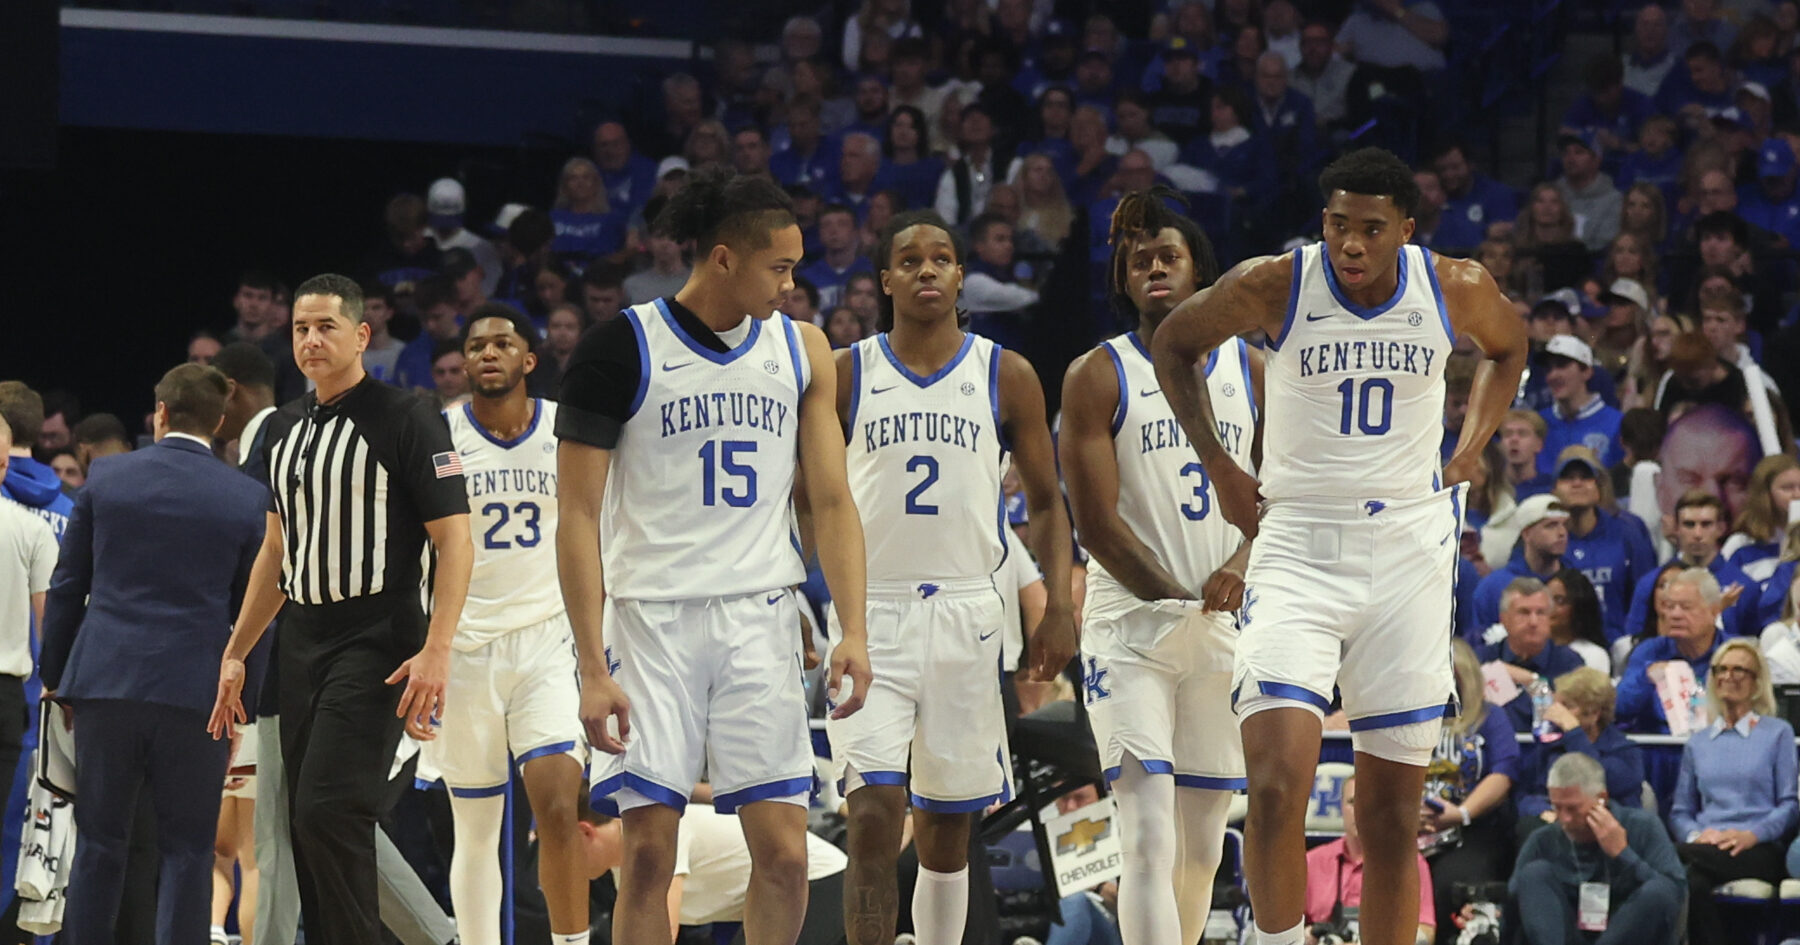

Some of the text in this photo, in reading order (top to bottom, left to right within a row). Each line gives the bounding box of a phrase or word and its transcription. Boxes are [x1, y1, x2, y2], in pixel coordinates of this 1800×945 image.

[1300, 341, 1435, 378] KENTUCKY
[661, 392, 788, 438] KENTUCKY
[1337, 378, 1394, 436] 10
[864, 412, 981, 454] KENTUCKY
[1140, 418, 1242, 455] KENKY
[698, 440, 758, 508] 15
[905, 455, 939, 516] 2
[1180, 462, 1210, 521] 3
[482, 501, 541, 550] 23
[1060, 852, 1121, 887] CHEVROLET
